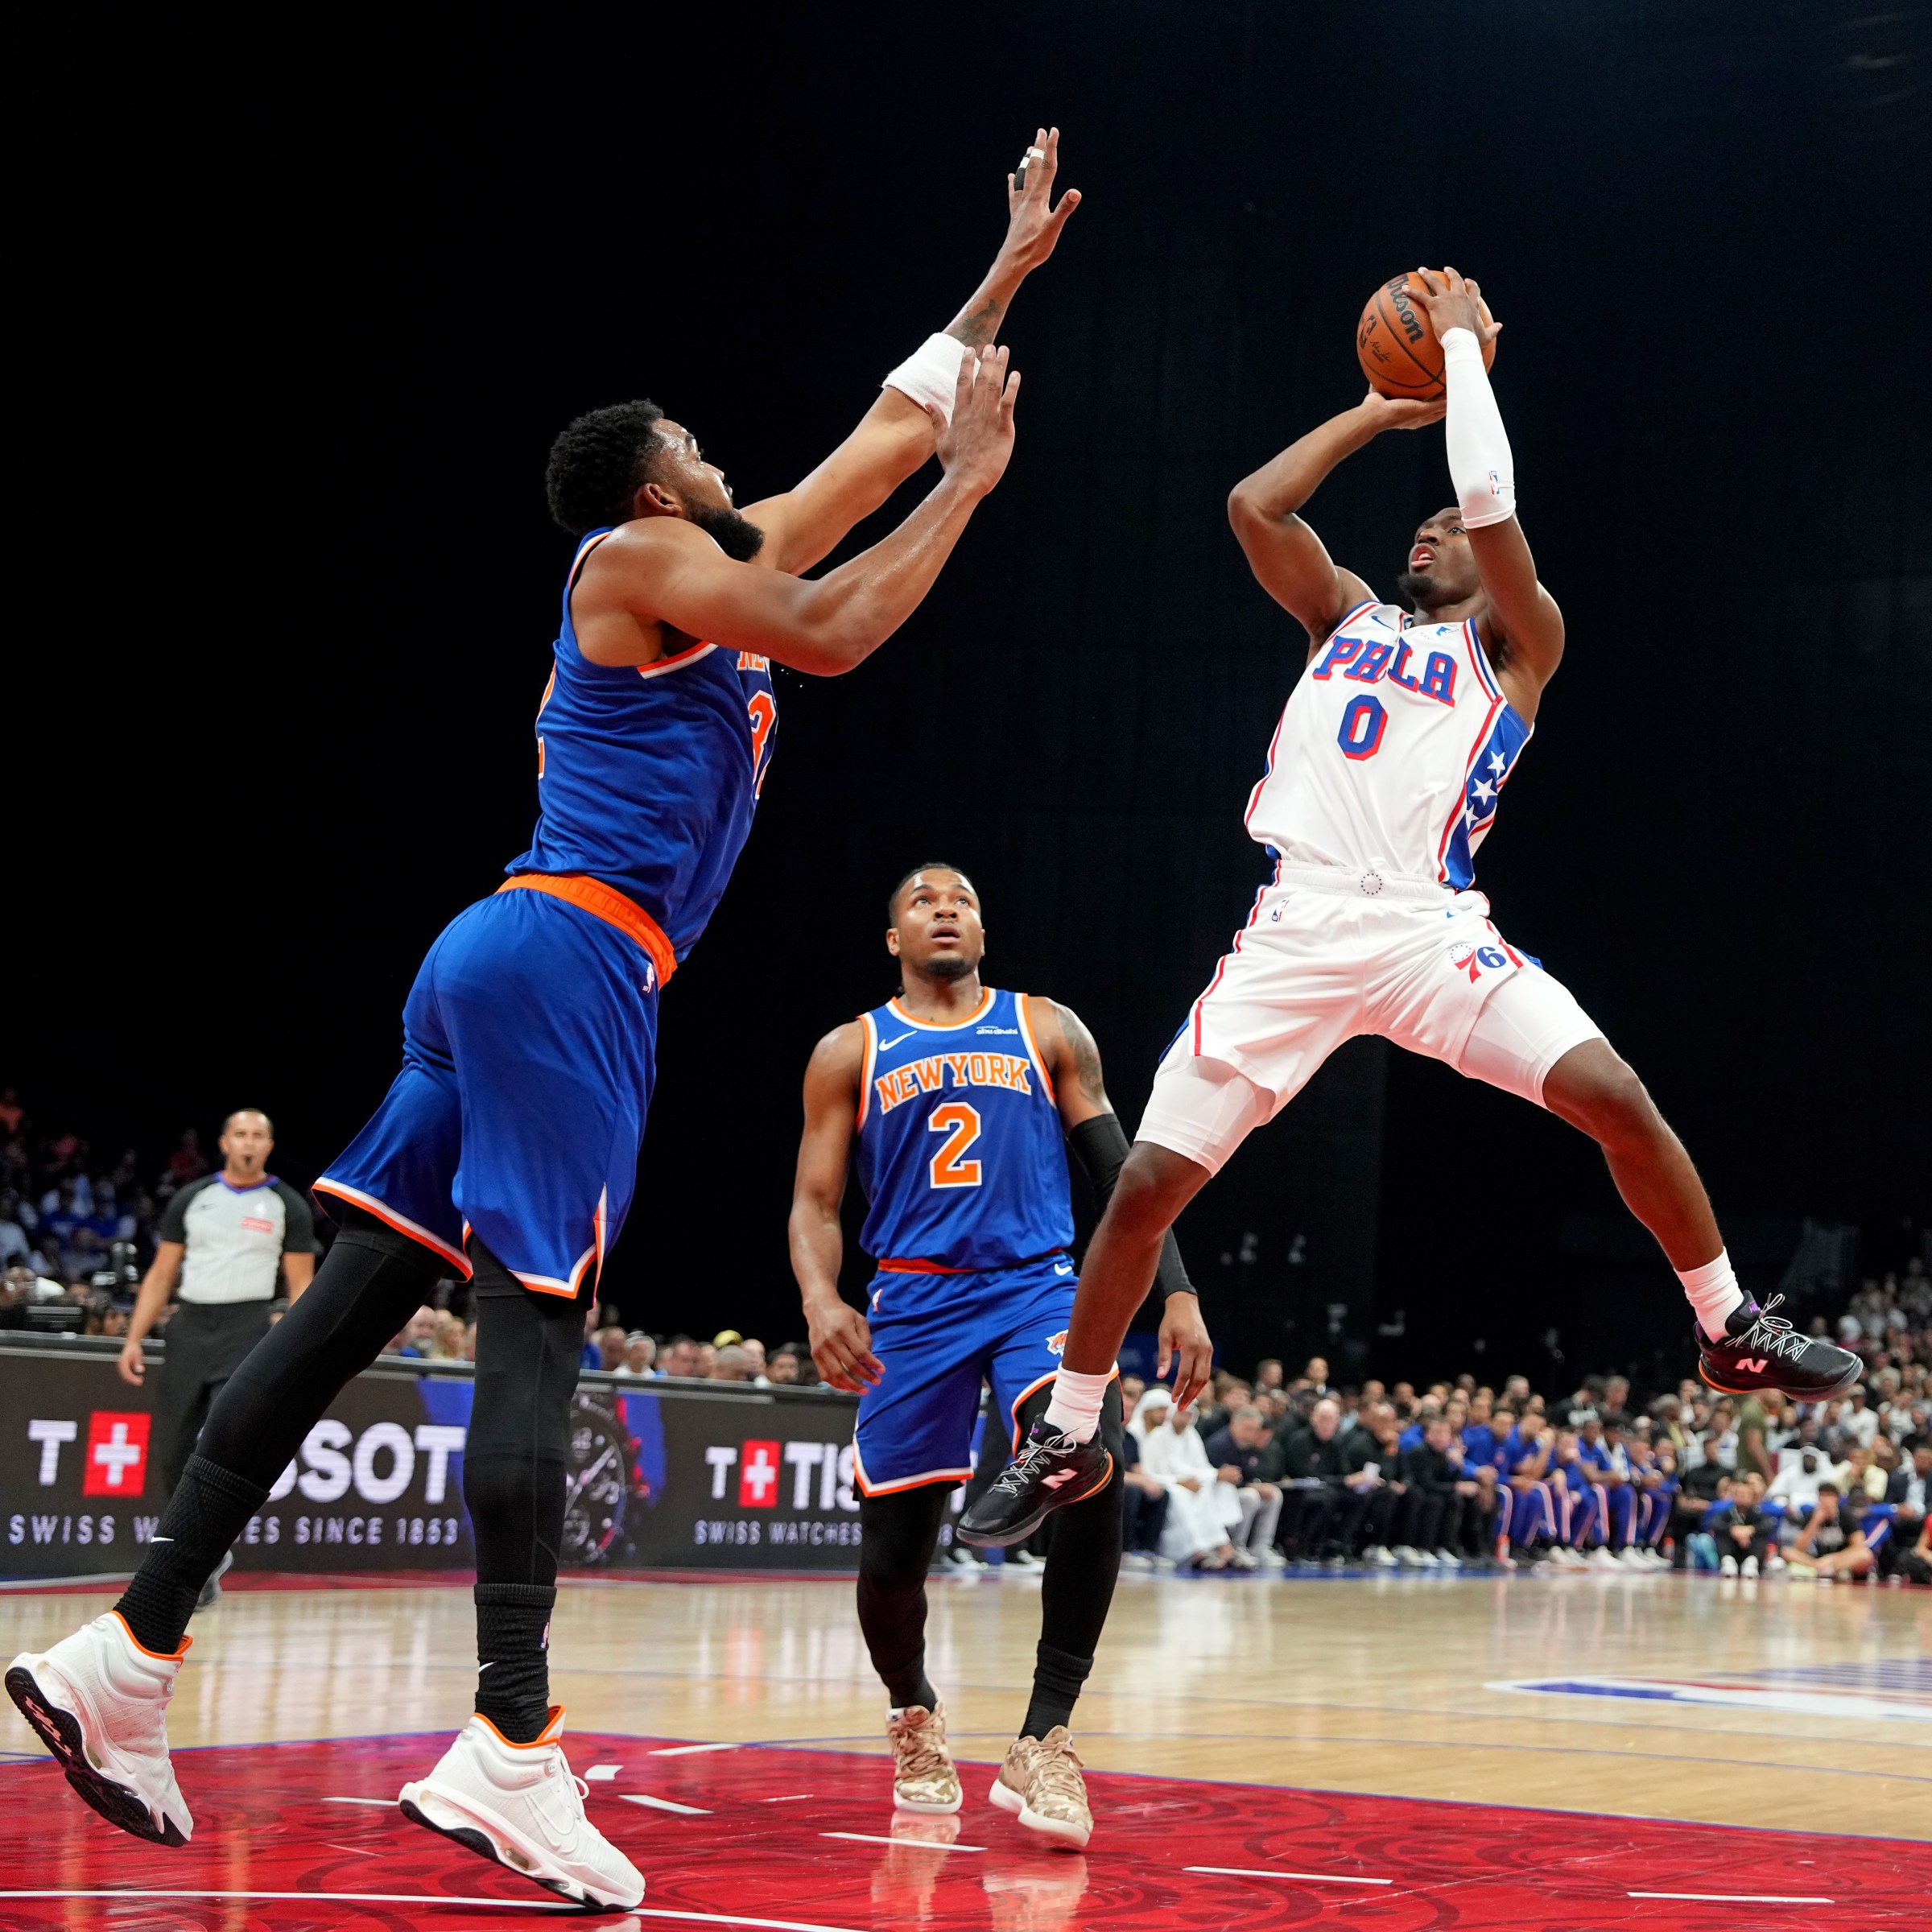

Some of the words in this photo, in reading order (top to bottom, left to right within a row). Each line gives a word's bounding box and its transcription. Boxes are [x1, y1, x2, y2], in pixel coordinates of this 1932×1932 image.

[1337, 694, 1389, 761] 0
[1454, 946, 1507, 985] 76
[928, 1102, 982, 1189] 2
[267, 1418, 466, 1504] SOT
[8, 1513, 115, 1545] SWISS
[295, 1515, 383, 1546] SINCE
[693, 1519, 762, 1546] SWISS
[767, 1521, 863, 1546] WATCHES
